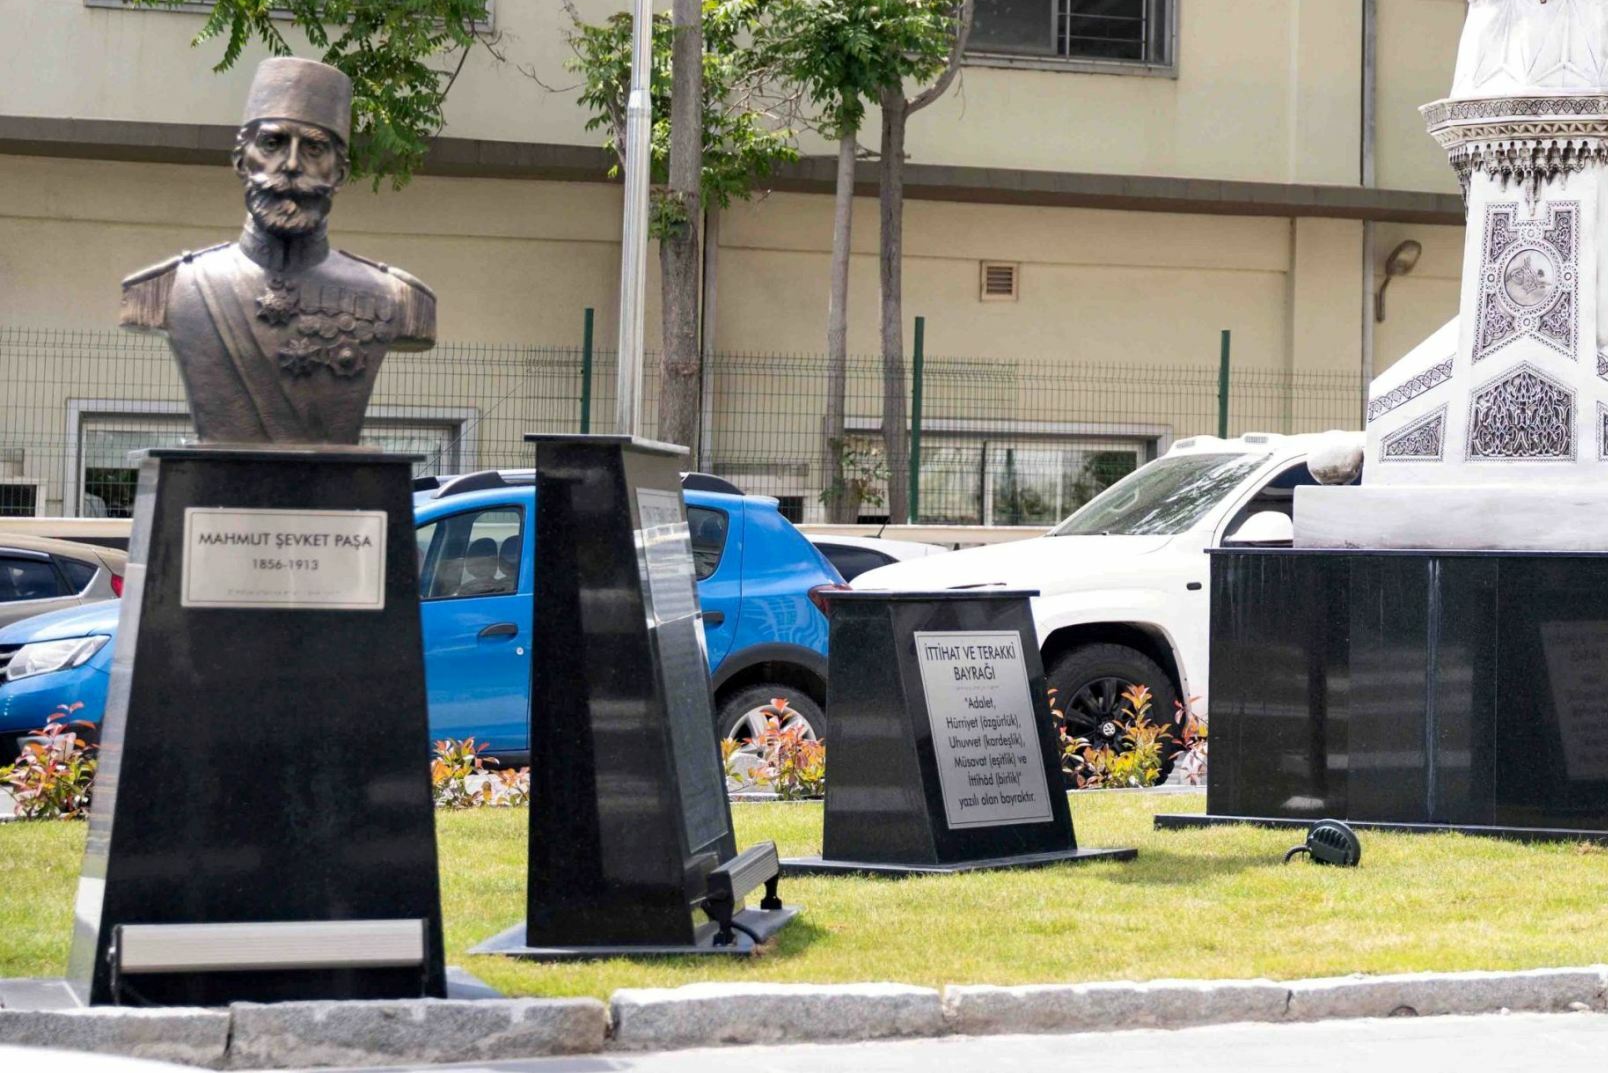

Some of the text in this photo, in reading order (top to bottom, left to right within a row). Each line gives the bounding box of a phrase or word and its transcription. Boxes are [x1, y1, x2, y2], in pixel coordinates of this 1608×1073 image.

[198, 532, 372, 550] MAHMUT ŞEVKET PAŞA
[253, 559, 319, 570] 1856-1913
[924, 641, 1017, 661] İTTİHAT VE TERAKKİ
[953, 663, 996, 681] BAYRAĞI
[946, 714, 1021, 732] Hürriyet (özgürlük),
[948, 733, 1026, 750] Uhuvvet (kardeşlik),
[954, 752, 1027, 769] Müsavat (eşitlik) ve
[959, 791, 1036, 810] yazılı olan bayraktır.
